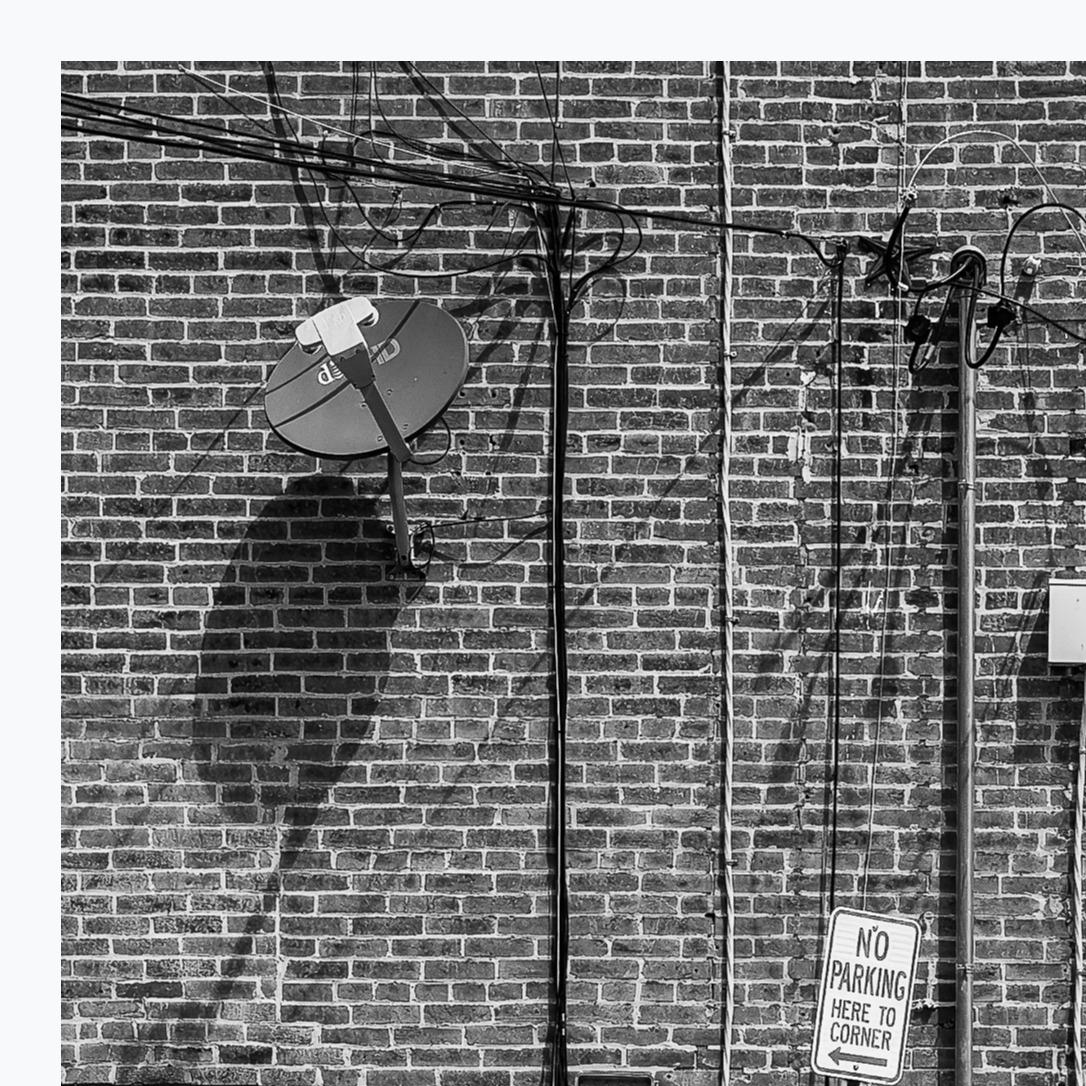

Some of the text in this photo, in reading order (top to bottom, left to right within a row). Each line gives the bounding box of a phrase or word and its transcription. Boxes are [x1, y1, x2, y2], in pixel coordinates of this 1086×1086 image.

[856, 927, 889, 961] NO
[829, 960, 907, 1001] PARKING
[831, 998, 896, 1027] HERE TO
[830, 1021, 892, 1051] CORNER
